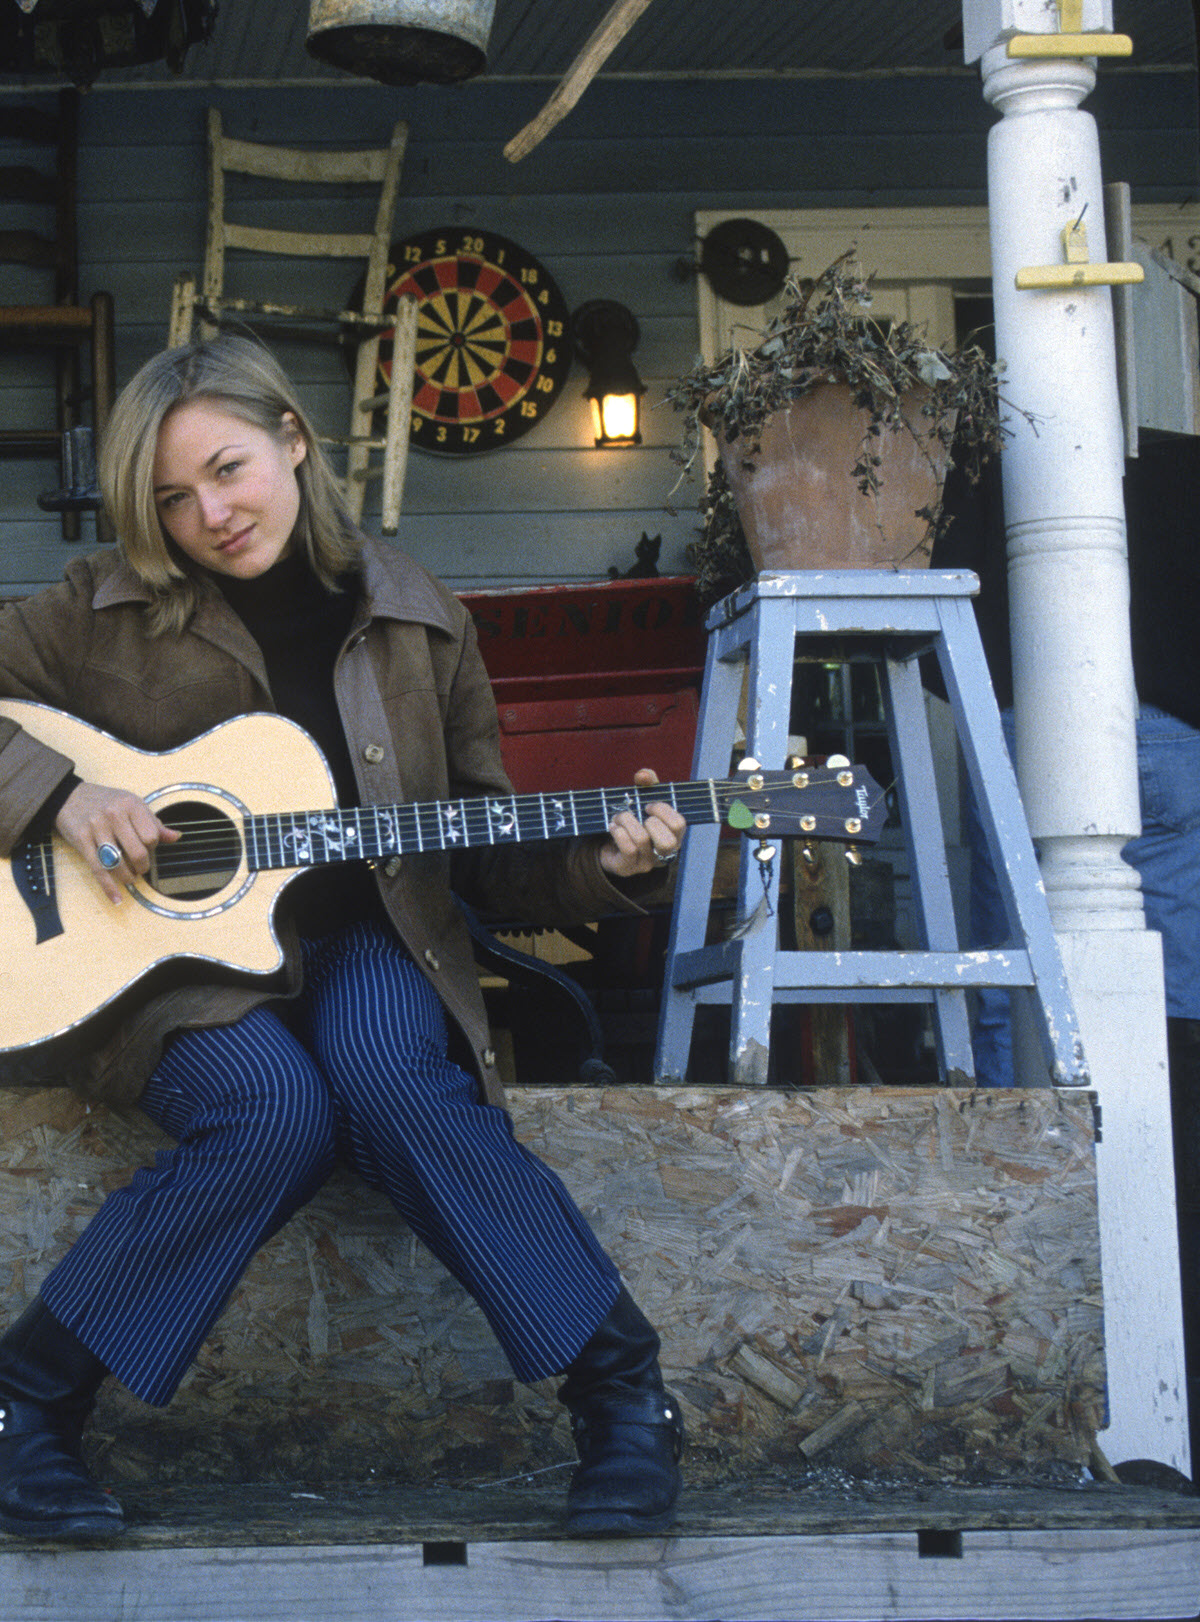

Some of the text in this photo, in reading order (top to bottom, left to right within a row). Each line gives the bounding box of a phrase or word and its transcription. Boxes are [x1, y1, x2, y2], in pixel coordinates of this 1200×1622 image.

[435, 239, 446, 255] 5
[463, 235, 484, 252] 20
[404, 245, 421, 262] 12
[497, 249, 505, 264] 1
[521, 267, 538, 284] 18
[538, 289, 549, 305] 4
[547, 319, 563, 337] 13
[546, 348, 557, 363] 6
[536, 374, 554, 393] 10
[521, 400, 537, 418] 15
[436, 426, 448, 442] 3
[463, 426, 480, 443] 17
[494, 418, 506, 434] 2
[855, 784, 871, 819] Taylor
